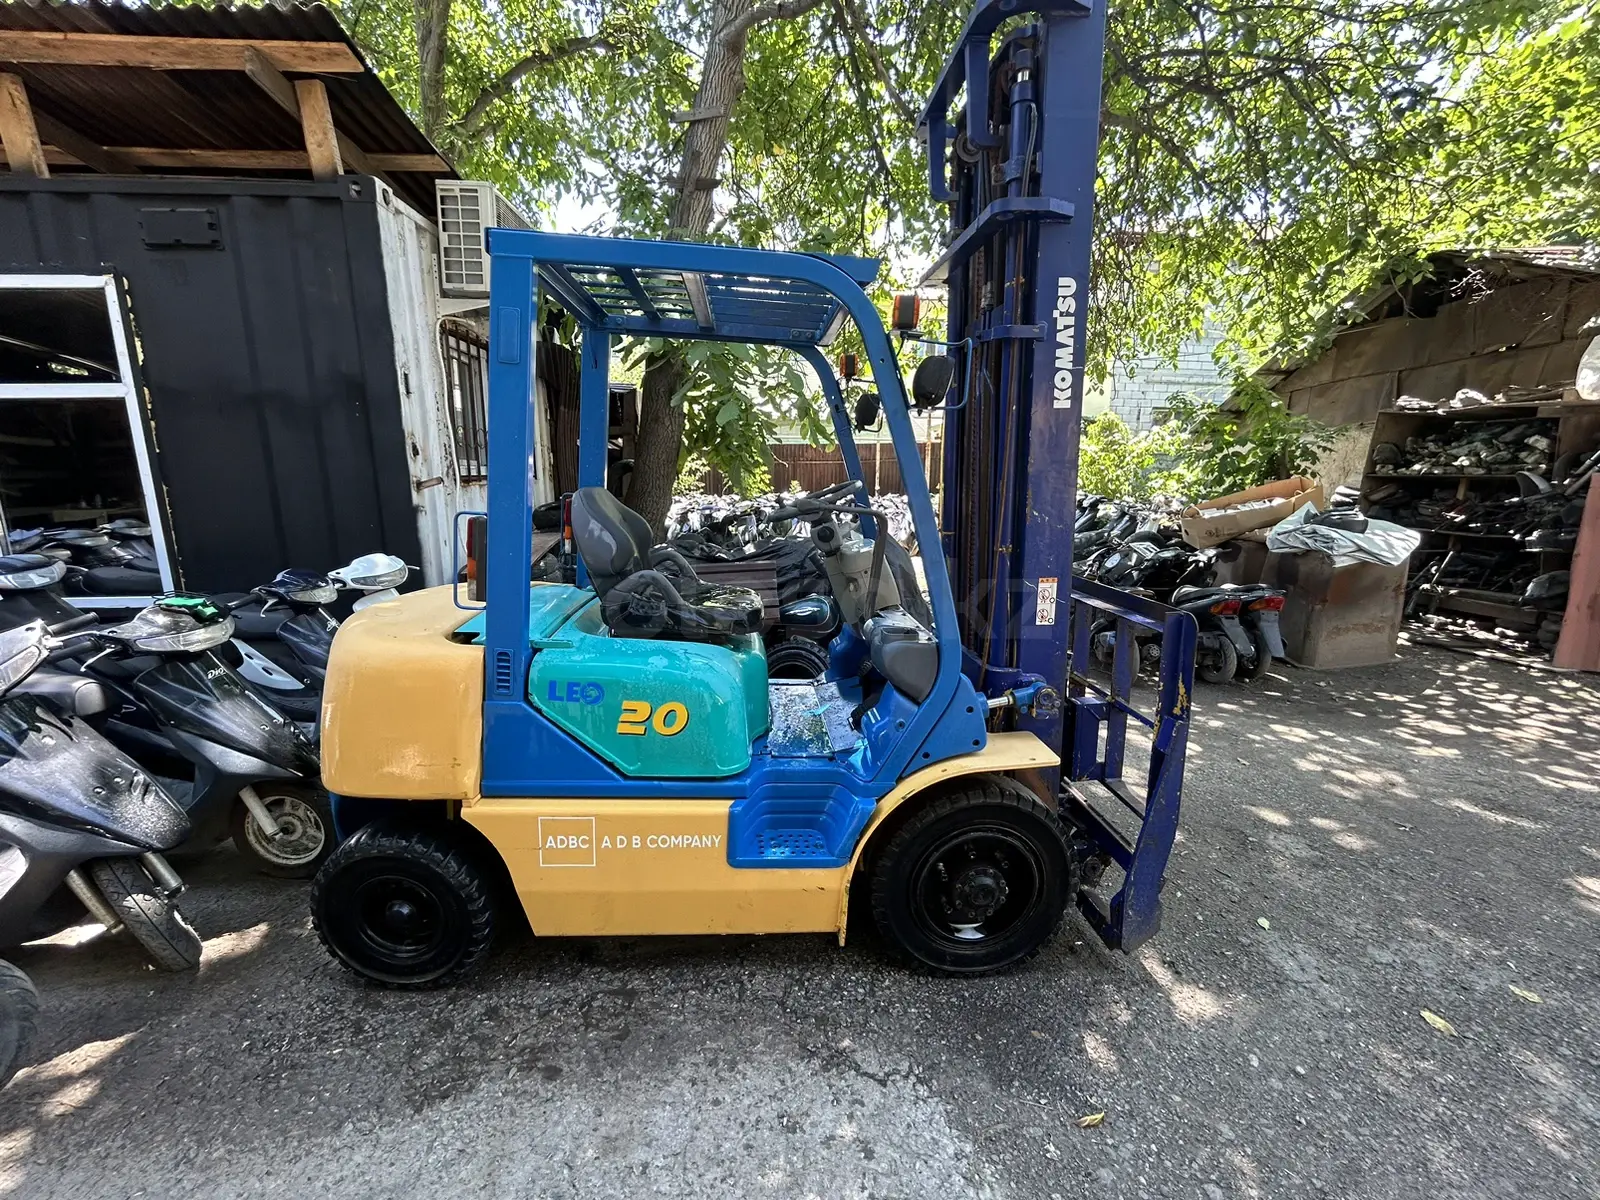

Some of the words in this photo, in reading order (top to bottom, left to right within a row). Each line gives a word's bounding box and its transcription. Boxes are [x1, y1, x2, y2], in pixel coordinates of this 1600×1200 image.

[1053, 276, 1077, 409] KOMATSU
[547, 680, 605, 705] LEO
[616, 700, 690, 736] 20
[545, 834, 590, 849] ADBC
[601, 834, 612, 849] A
[616, 834, 627, 849] D
[632, 834, 641, 848] B
[646, 833, 722, 849] COMPANY
